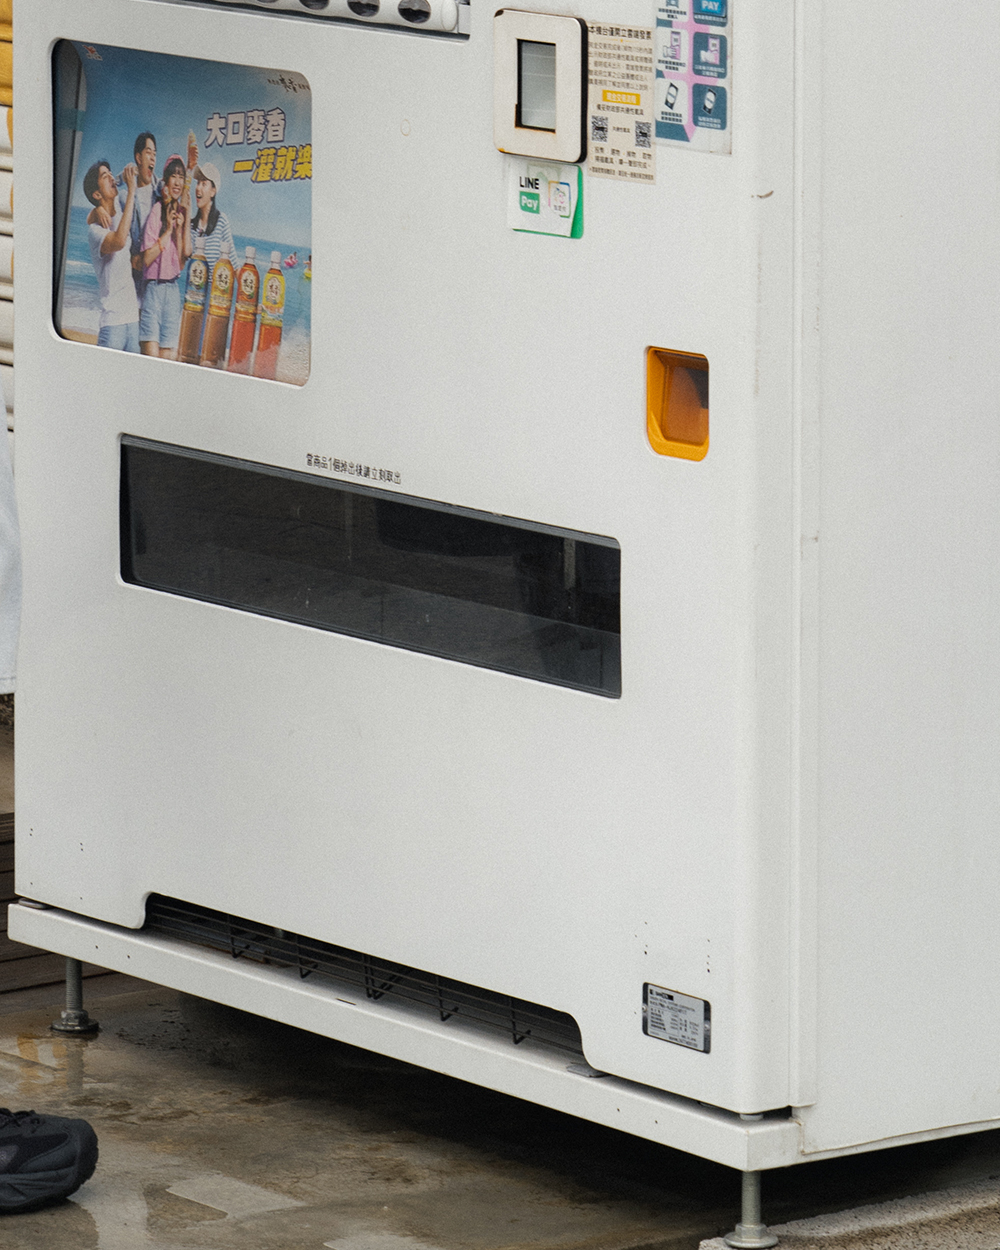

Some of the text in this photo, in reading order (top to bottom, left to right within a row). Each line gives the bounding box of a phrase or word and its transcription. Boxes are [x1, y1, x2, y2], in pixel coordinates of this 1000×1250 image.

[702, 0, 719, 10] PAY
[204, 107, 286, 148] 大口麥香
[233, 144, 312, 184] 一灌就樂
[520, 176, 540, 190] LINE
[521, 195, 539, 211] Pay
